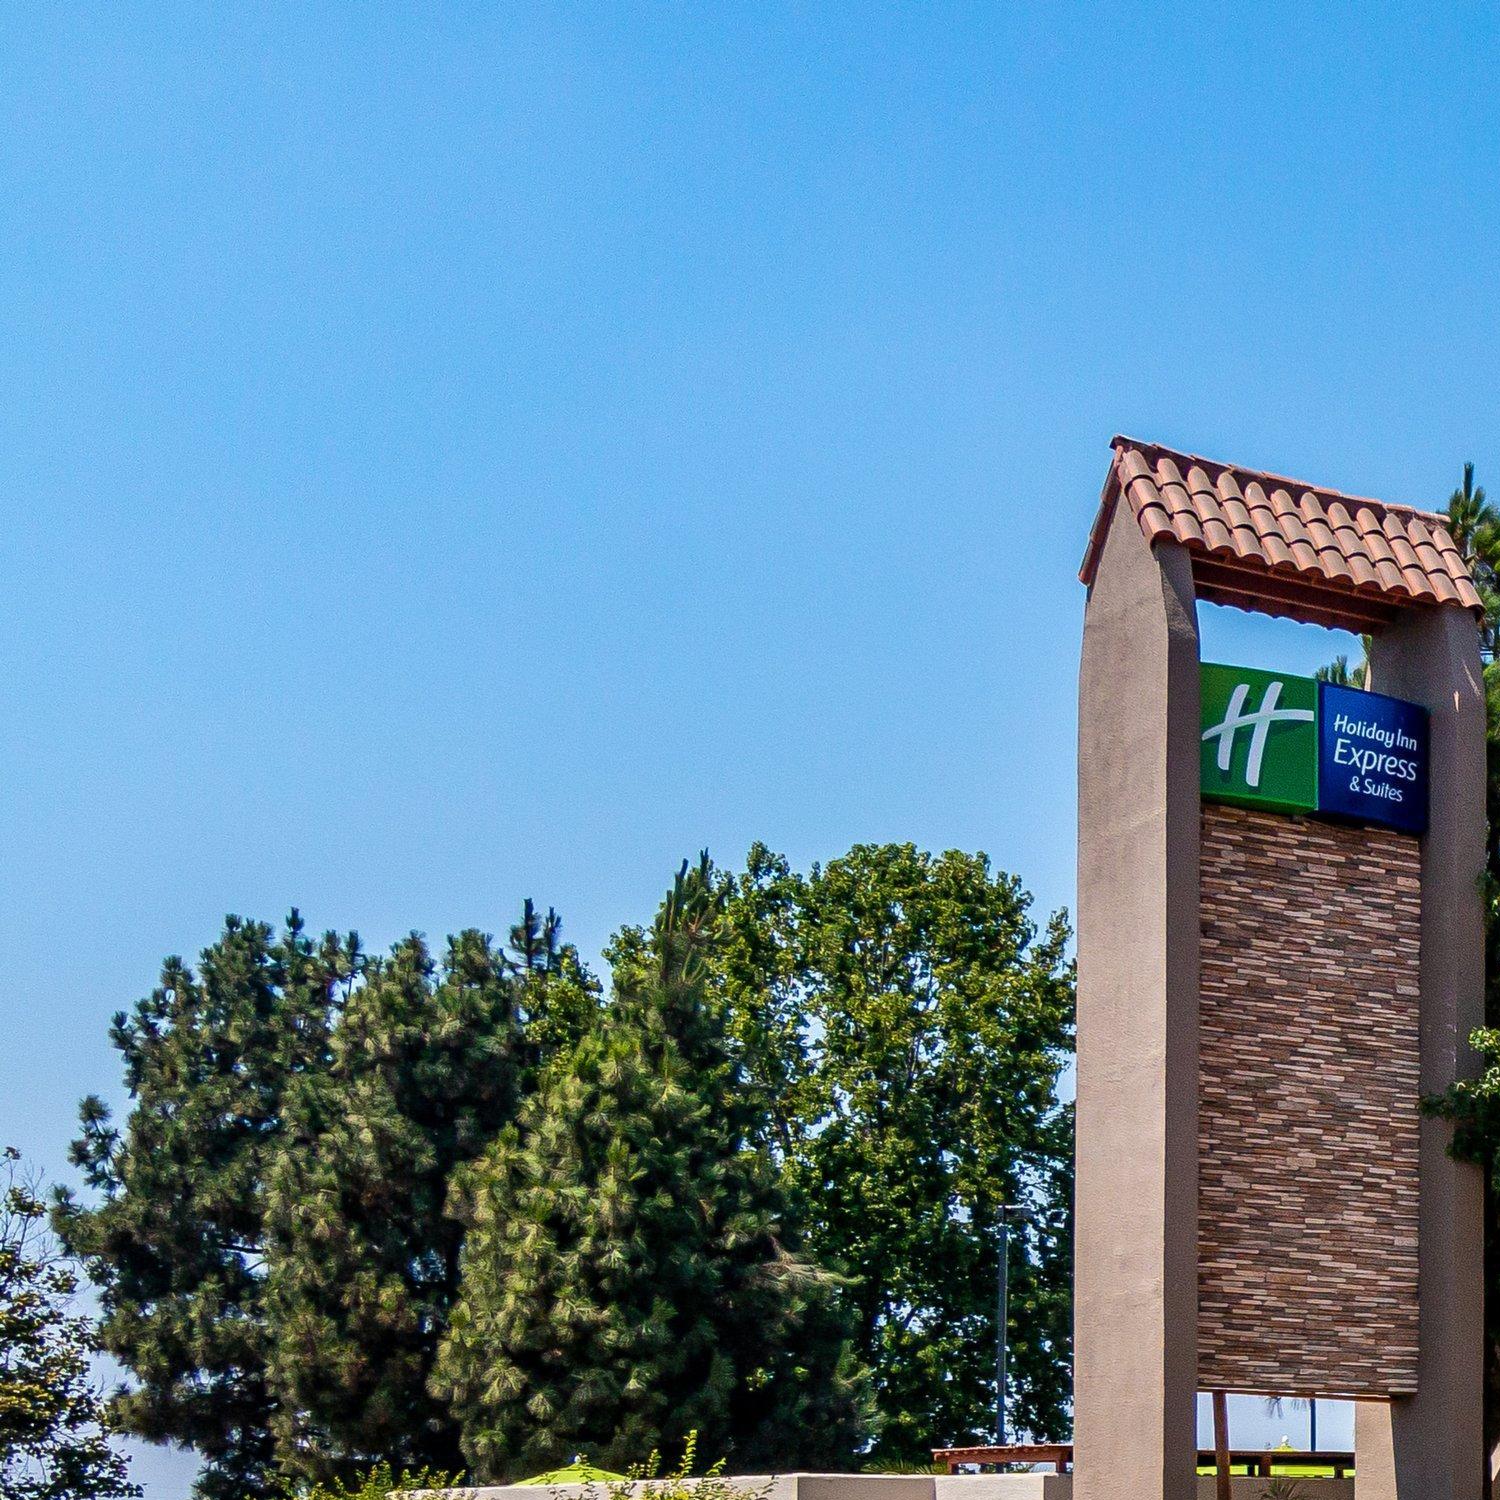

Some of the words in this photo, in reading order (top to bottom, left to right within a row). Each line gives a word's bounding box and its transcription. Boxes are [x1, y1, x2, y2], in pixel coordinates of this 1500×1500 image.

[1333, 713, 1395, 748] Holiday
[1396, 728, 1418, 751] Inn
[1333, 738, 1418, 781] Express
[1349, 775, 1361, 792] &
[1363, 778, 1404, 802] Suites
